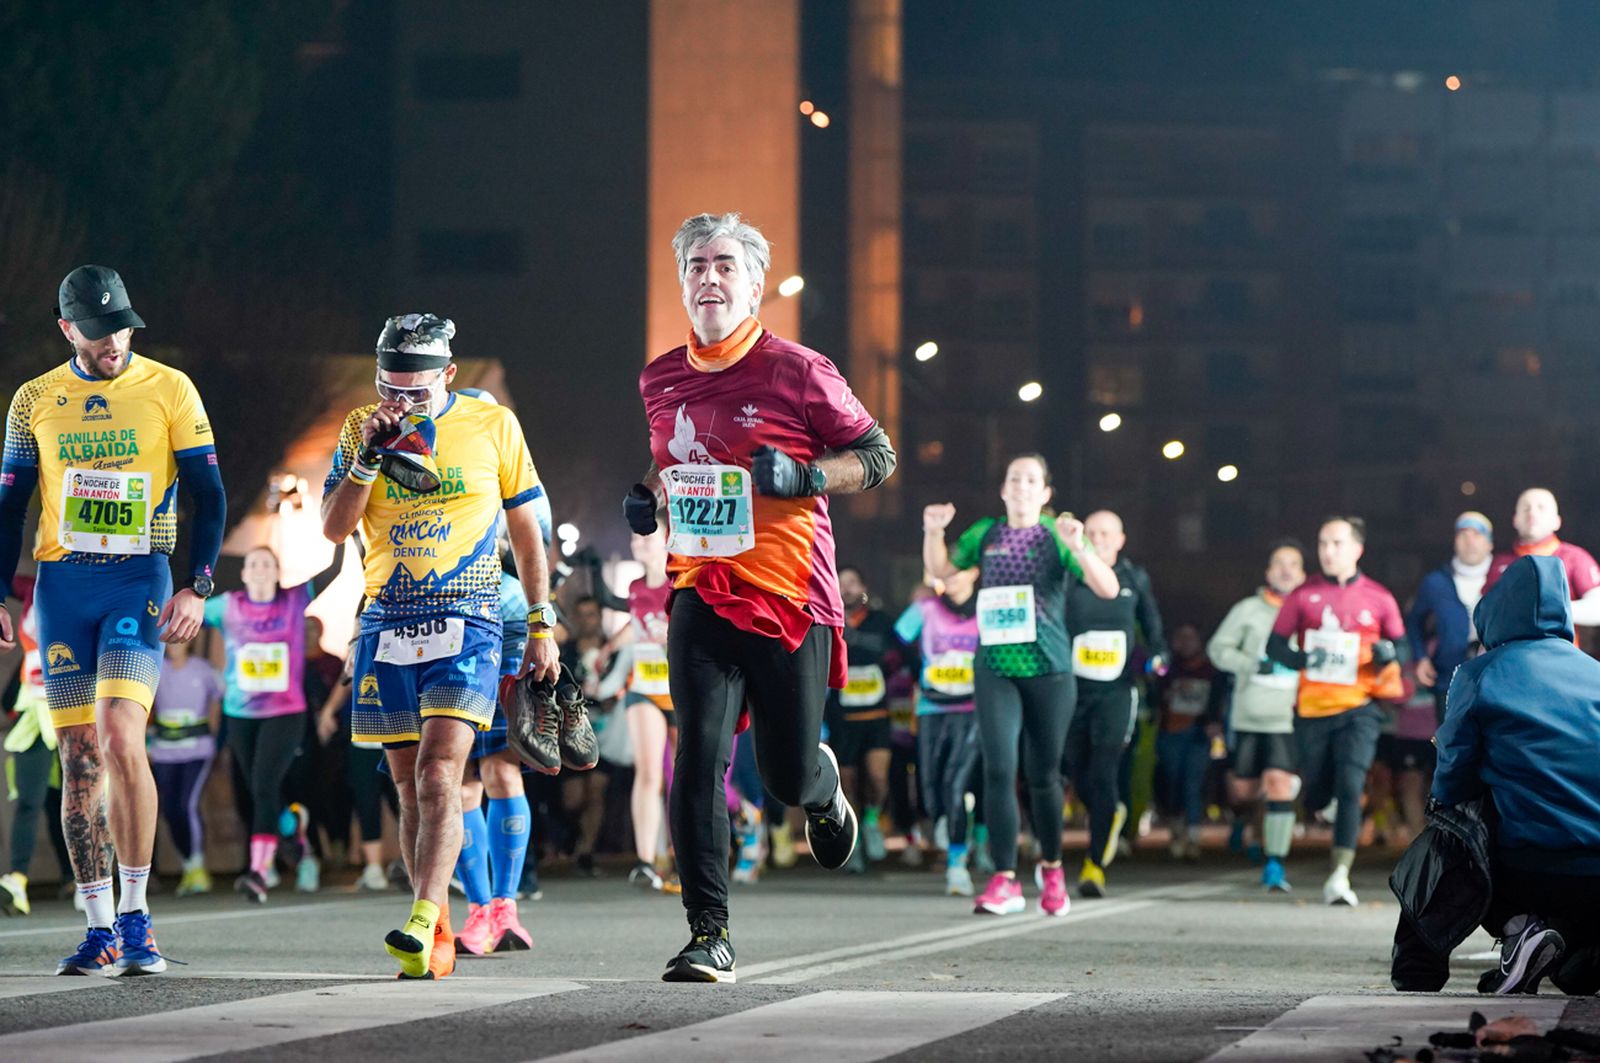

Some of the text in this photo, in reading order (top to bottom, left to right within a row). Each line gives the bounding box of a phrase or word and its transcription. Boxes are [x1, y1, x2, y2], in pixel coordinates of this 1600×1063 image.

[58, 429, 136, 445] CANILLAS DE
[58, 442, 139, 461] ALBAIDA
[447, 467, 463, 479] DE
[83, 479, 120, 490] NOCHE DE
[73, 487, 89, 497] SAN
[91, 489, 120, 499] ANTÓN
[78, 500, 132, 526] 4705
[676, 498, 736, 526] 12227
[393, 547, 438, 558] DENTAL
